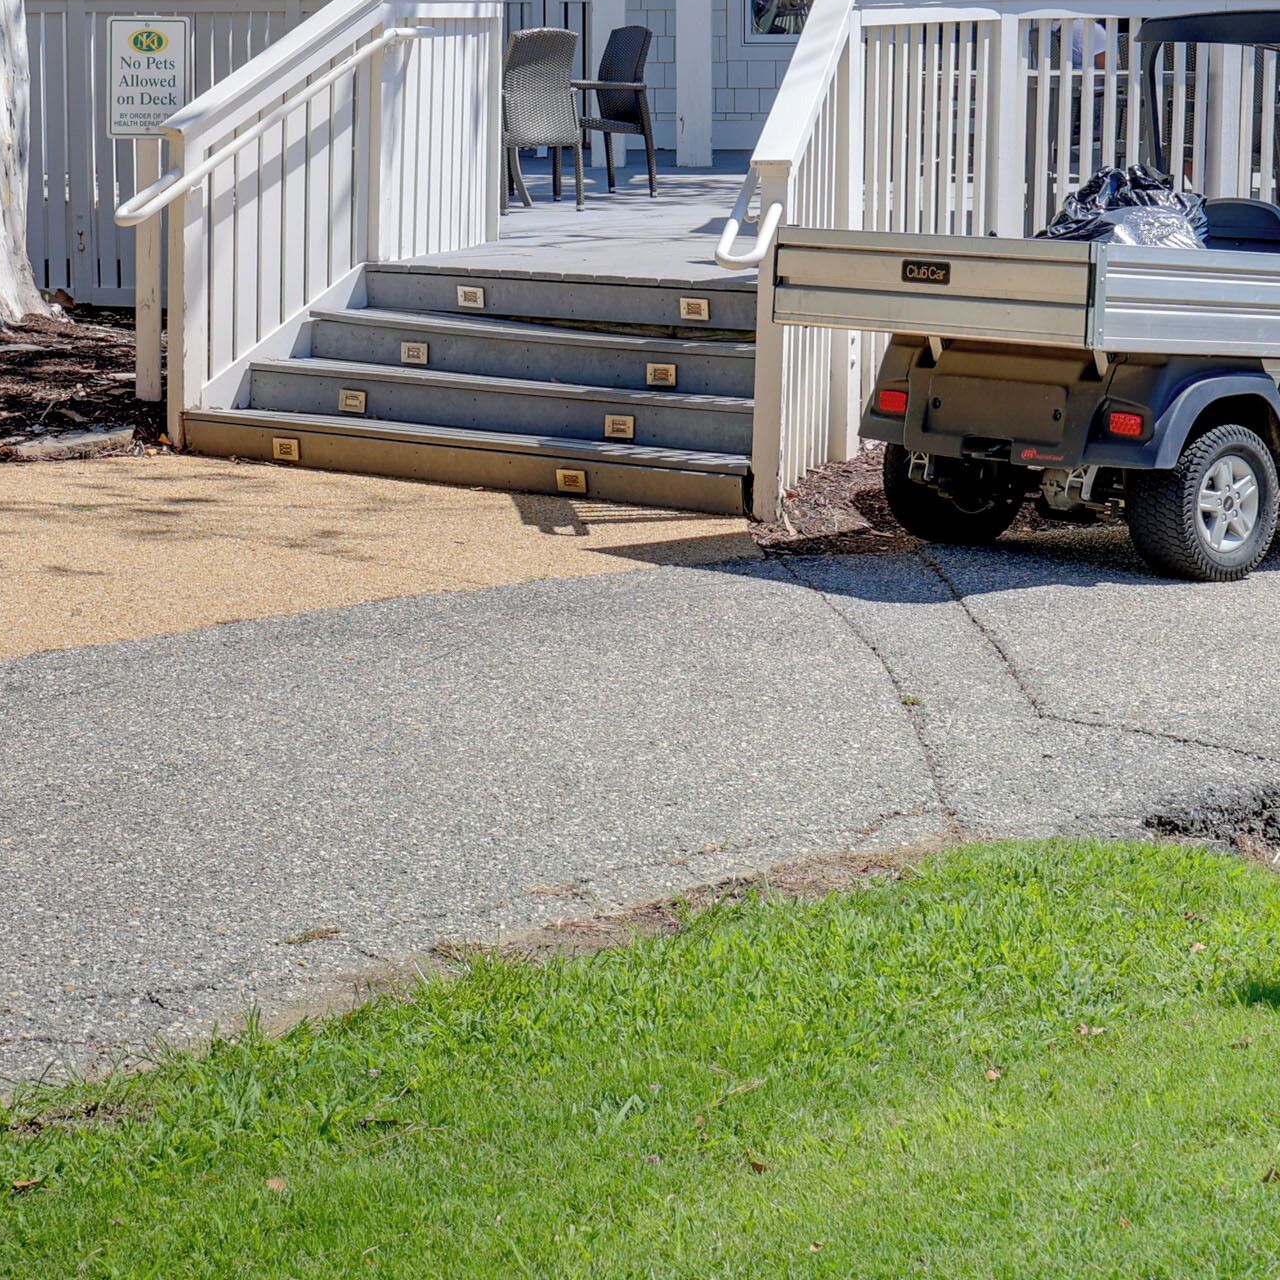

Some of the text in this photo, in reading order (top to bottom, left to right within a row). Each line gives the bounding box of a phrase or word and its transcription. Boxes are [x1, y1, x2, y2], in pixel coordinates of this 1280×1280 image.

[120, 56, 176, 70] No Pets
[118, 74, 176, 87] Allowed
[117, 92, 177, 105] on Deck
[906, 265, 945, 280] Club Car
